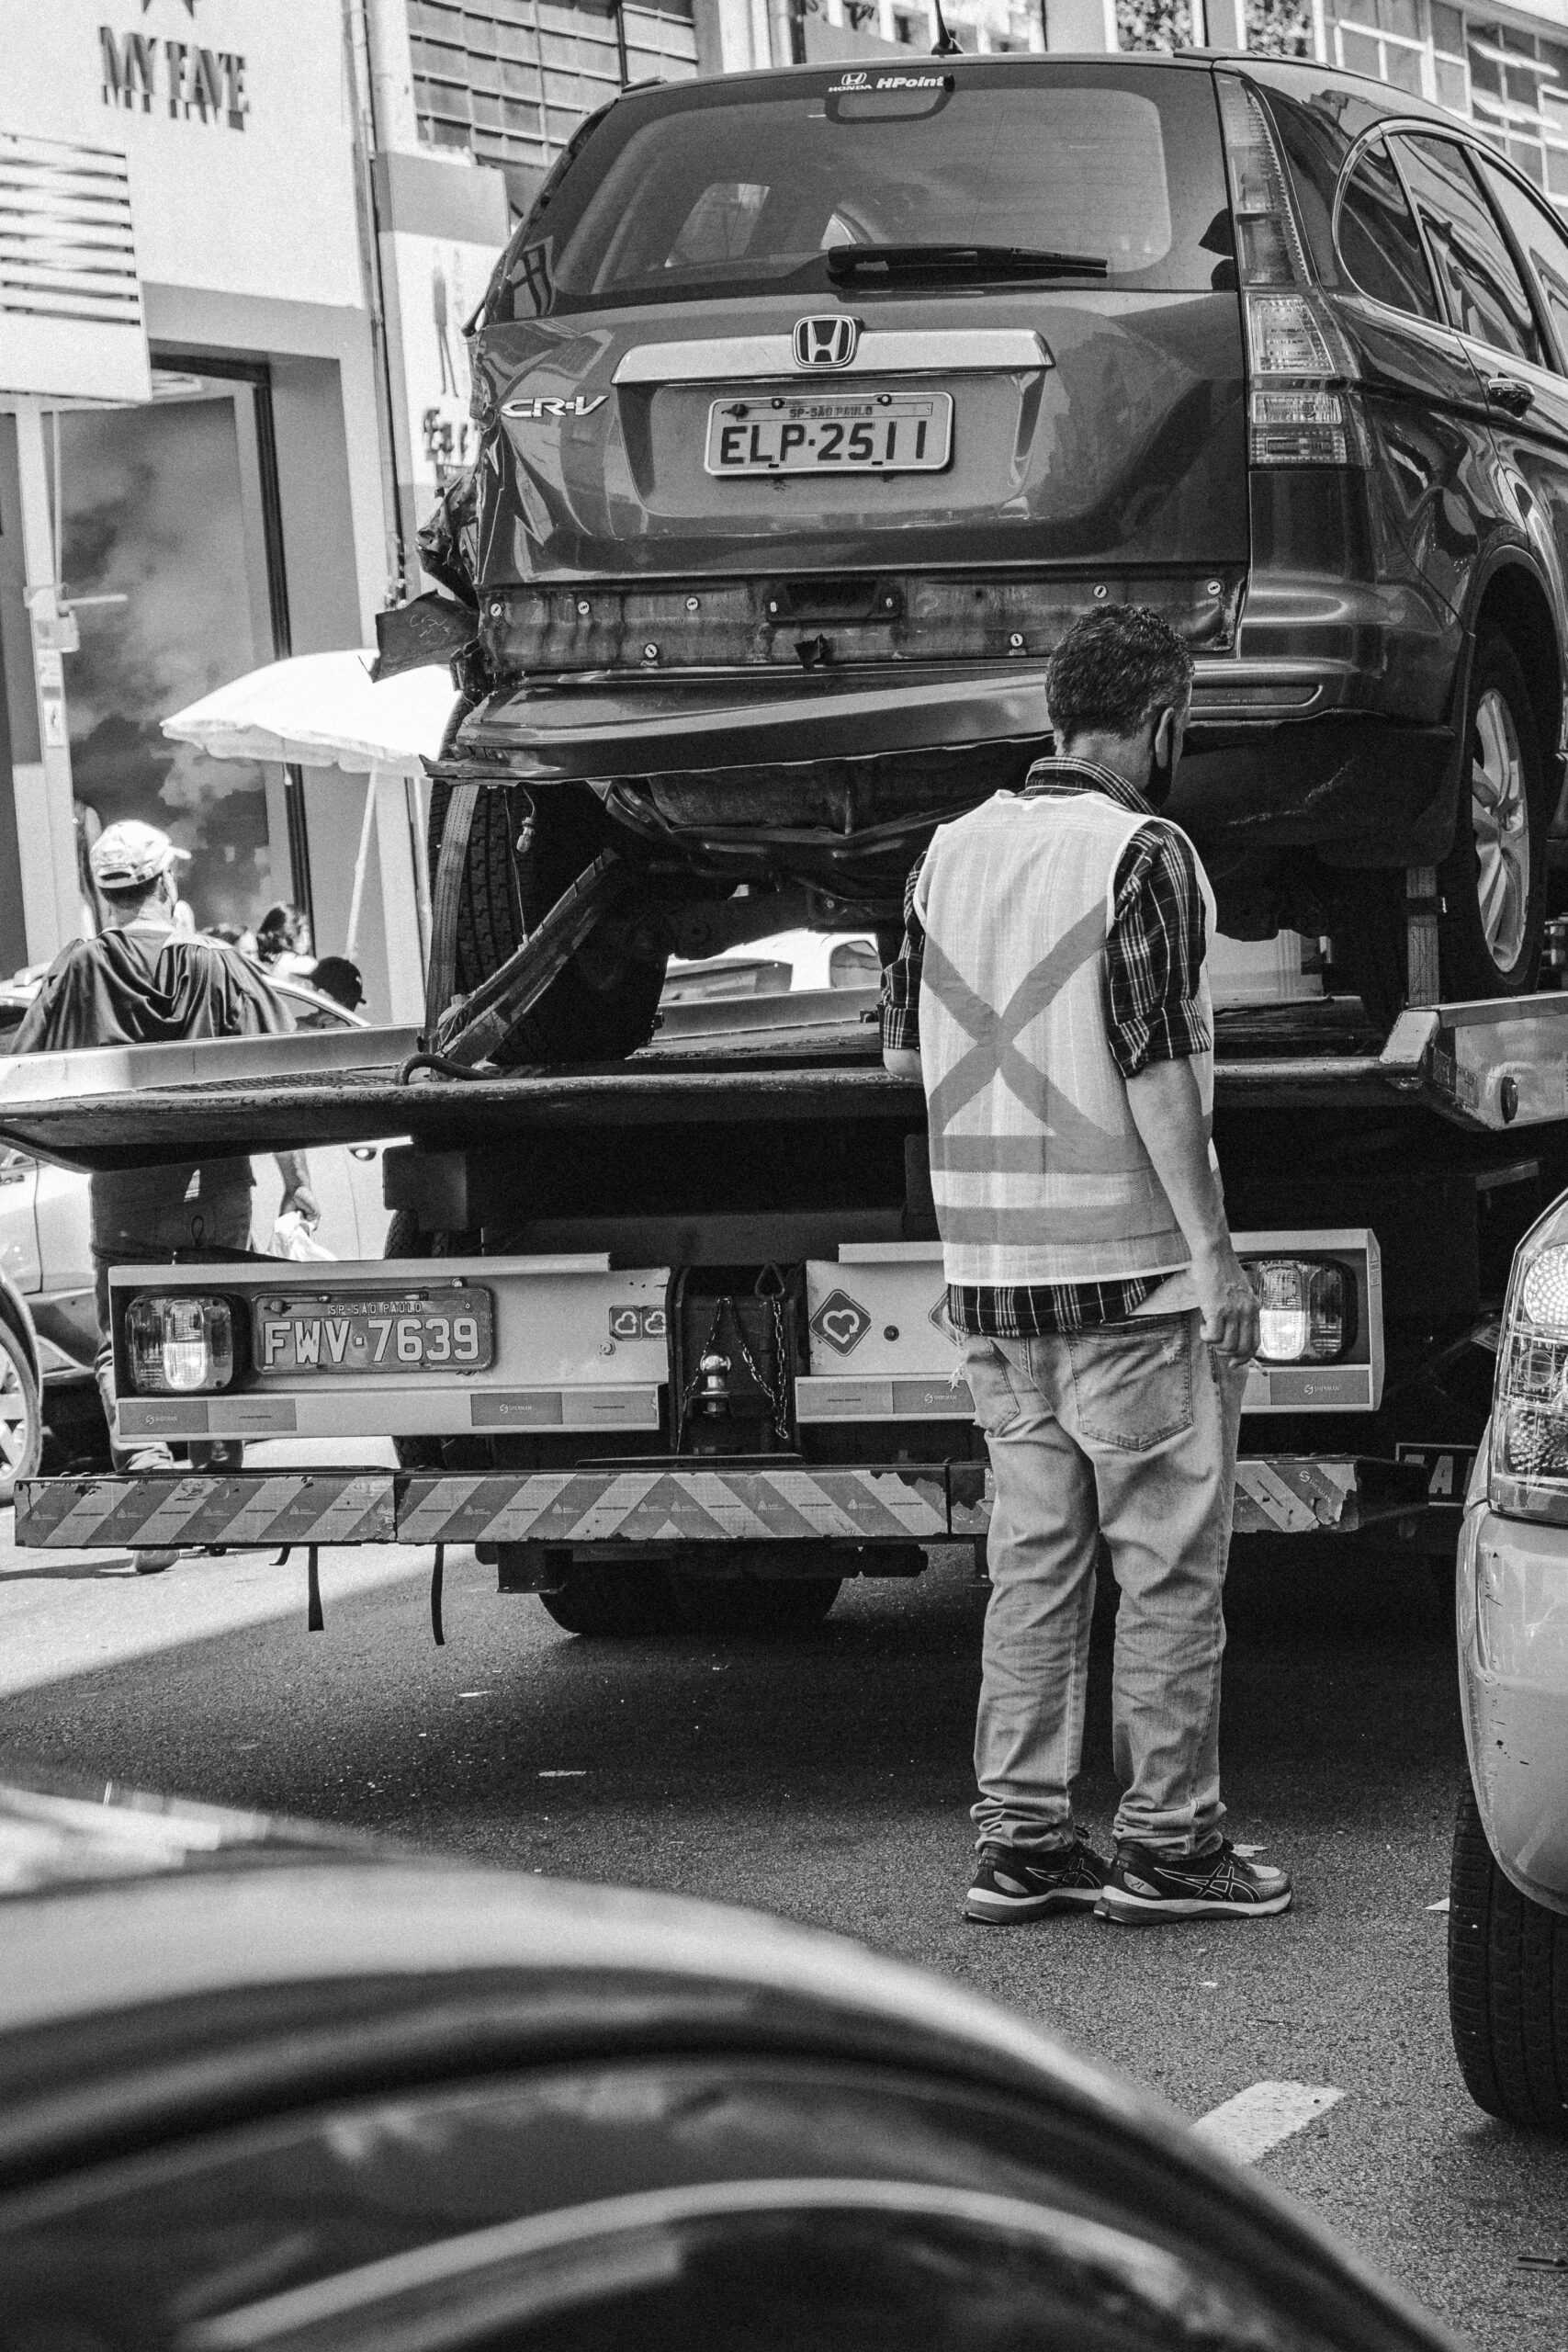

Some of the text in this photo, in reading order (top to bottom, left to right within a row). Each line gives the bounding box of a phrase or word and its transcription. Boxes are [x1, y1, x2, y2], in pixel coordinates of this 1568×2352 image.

[99, 26, 250, 130] MY FAVE
[876, 76, 944, 89] HPoint
[501, 395, 609, 418] CR-V
[835, 405, 874, 416] PAULO
[383, 1302, 423, 1314] PAULO
